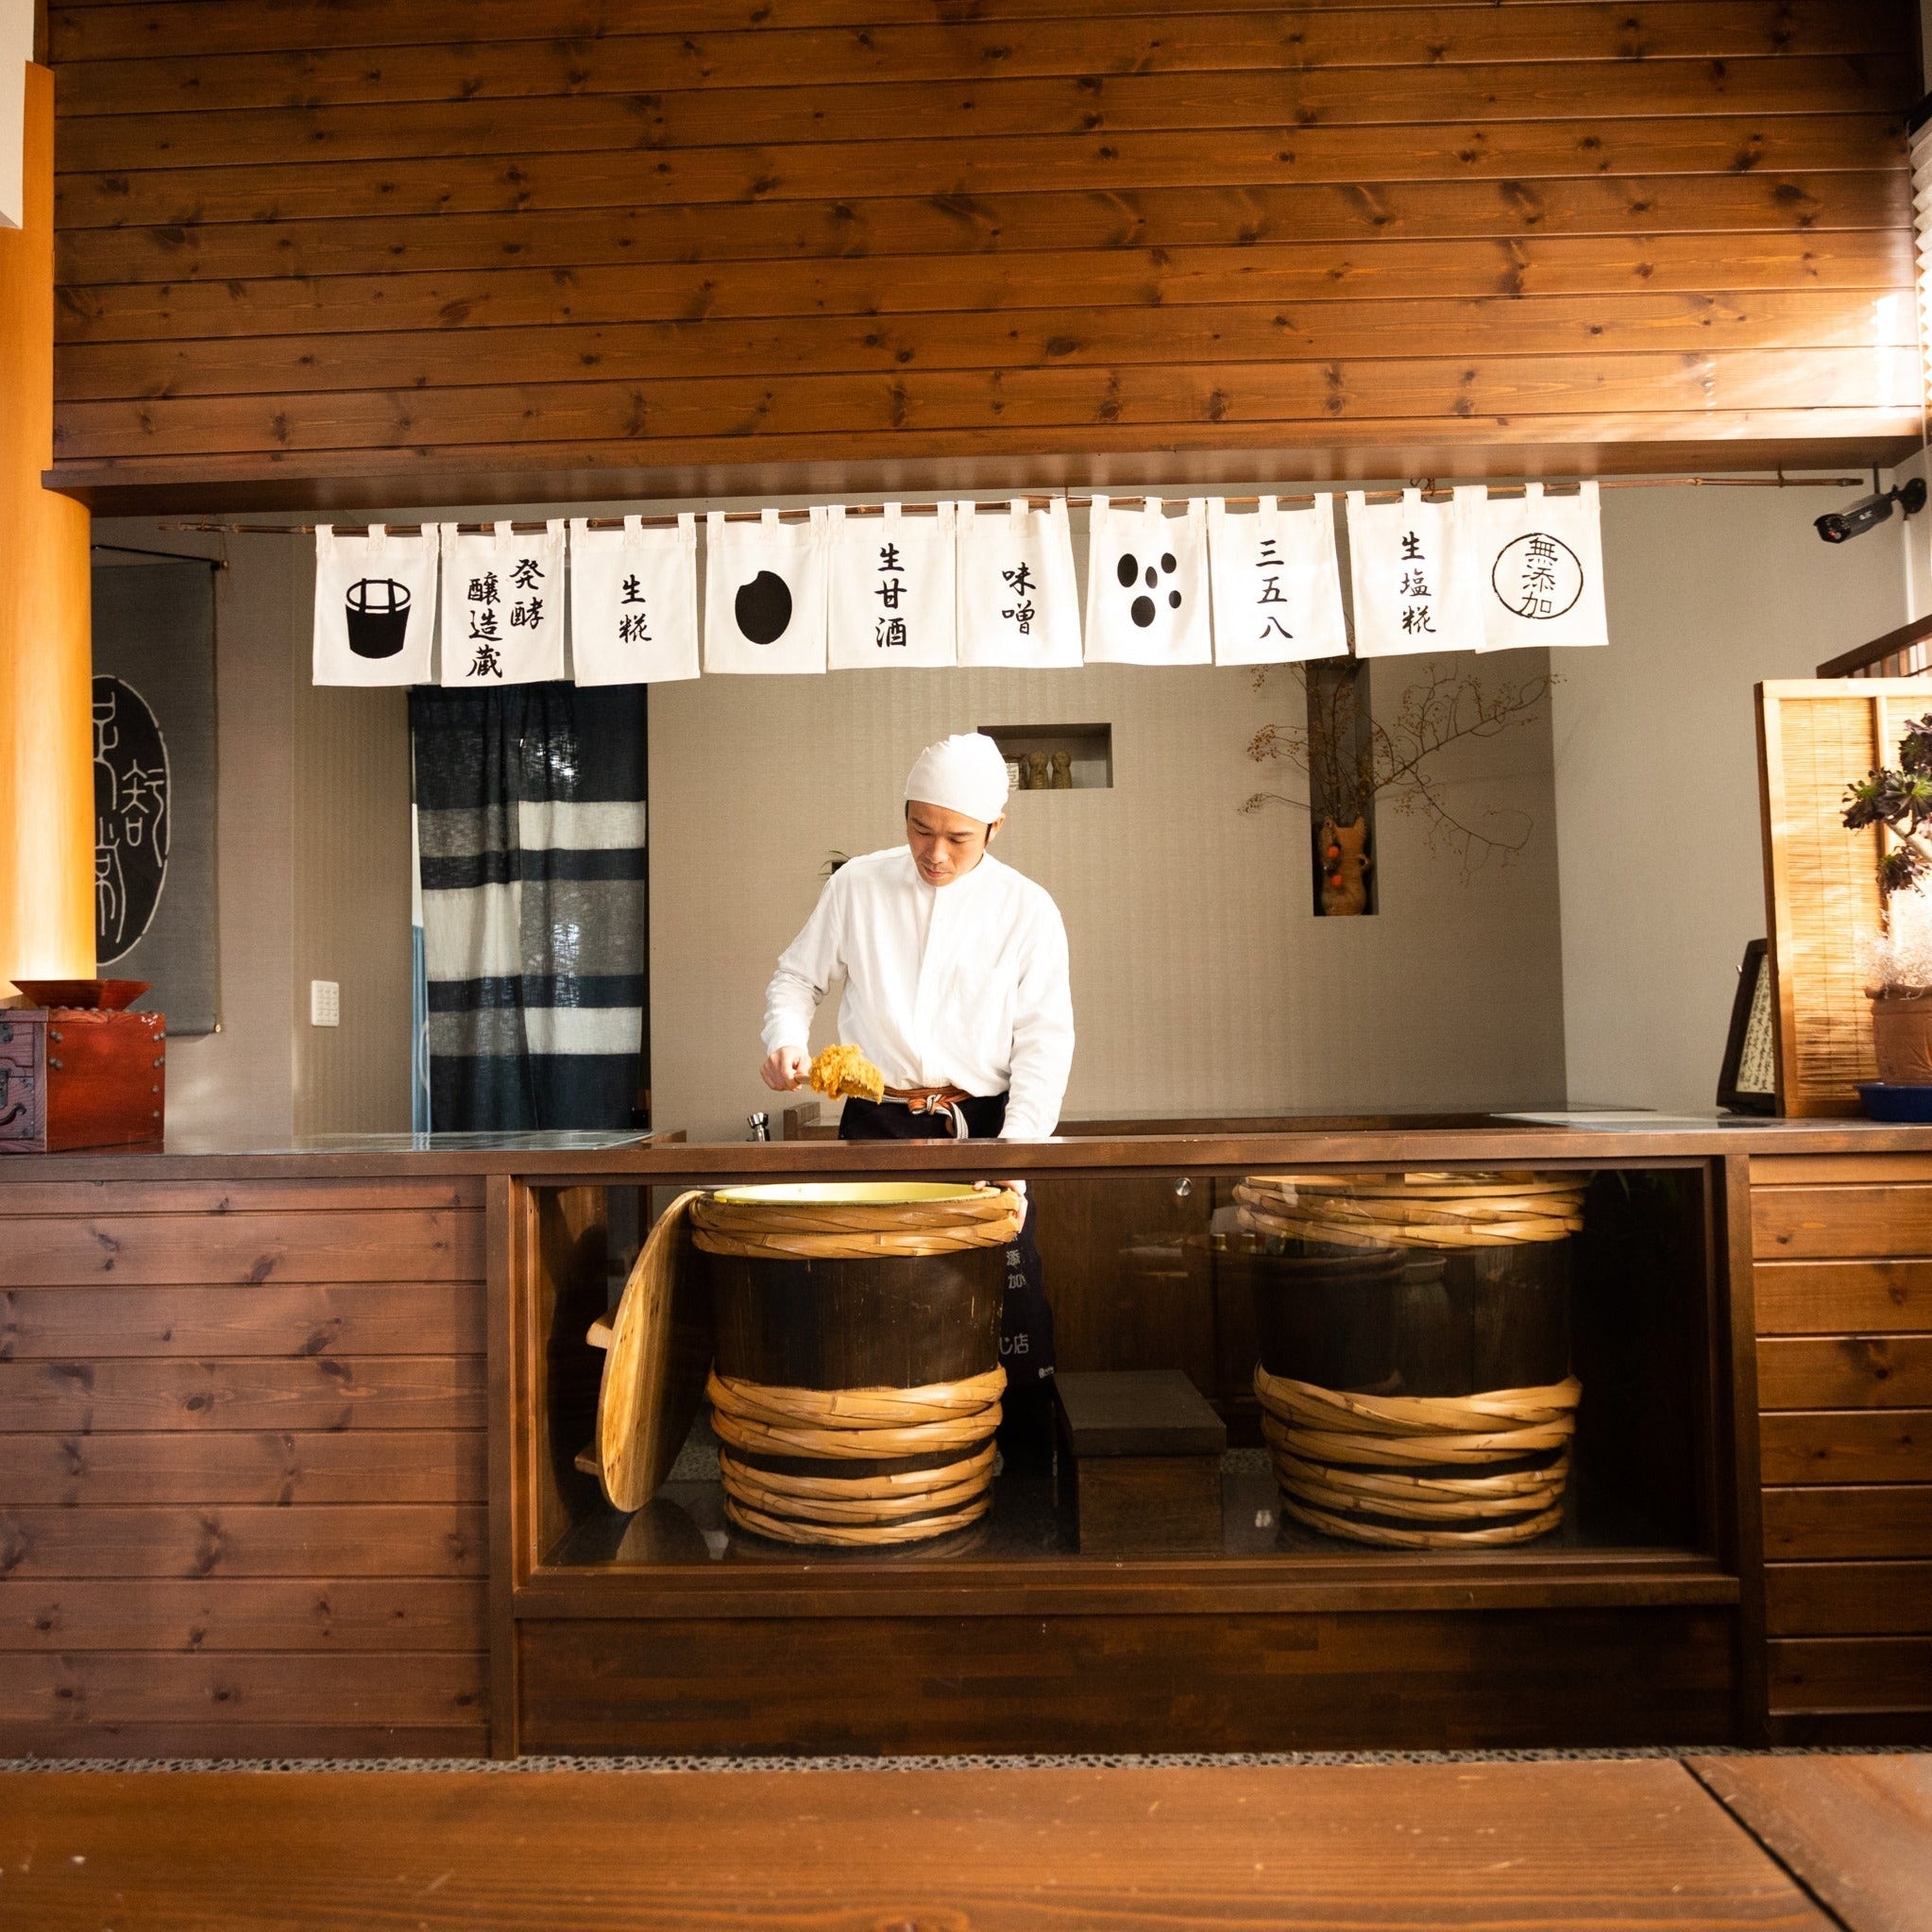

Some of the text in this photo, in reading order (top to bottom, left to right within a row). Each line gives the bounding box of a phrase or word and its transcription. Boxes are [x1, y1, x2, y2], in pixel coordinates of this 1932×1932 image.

[510, 559, 545, 630] 発酵
[619, 574, 652, 644] 生糀
[874, 543, 907, 648] 生甘酒
[1001, 562, 1037, 636] 味噌
[1256, 539, 1294, 639] 三五八
[1399, 531, 1436, 635] 生塩糀
[1519, 537, 1558, 617] 無添加
[466, 571, 503, 678] 醸造蔵
[1006, 1236, 1026, 1289] 添加
